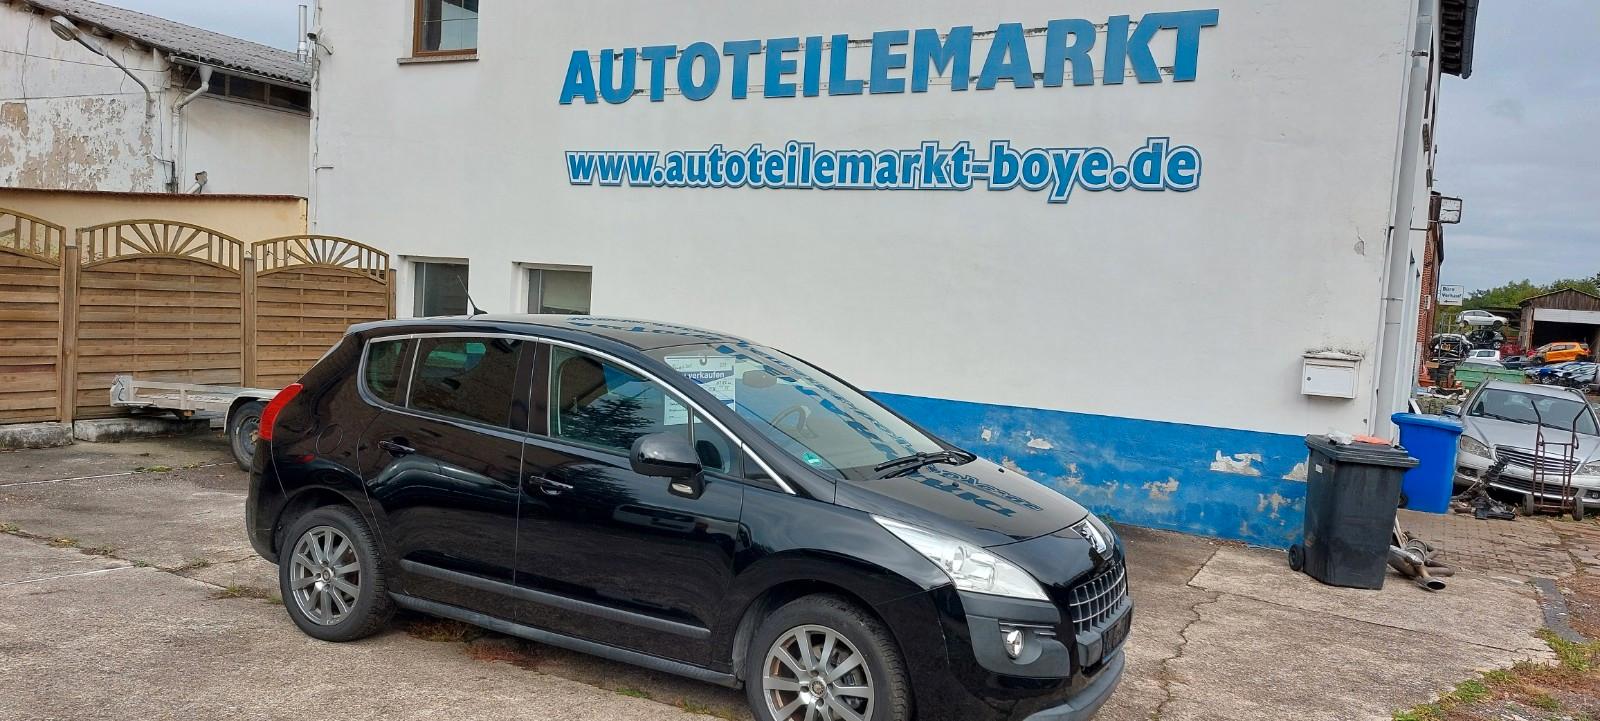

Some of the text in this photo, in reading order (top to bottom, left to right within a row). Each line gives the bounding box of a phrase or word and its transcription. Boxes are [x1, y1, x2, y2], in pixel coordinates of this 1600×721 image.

[559, 9, 1220, 105] AUTOTEILEMARKT
[566, 138, 1202, 204] www.autoteilemarkt-boye.de
[688, 371, 725, 379] verkaufen
